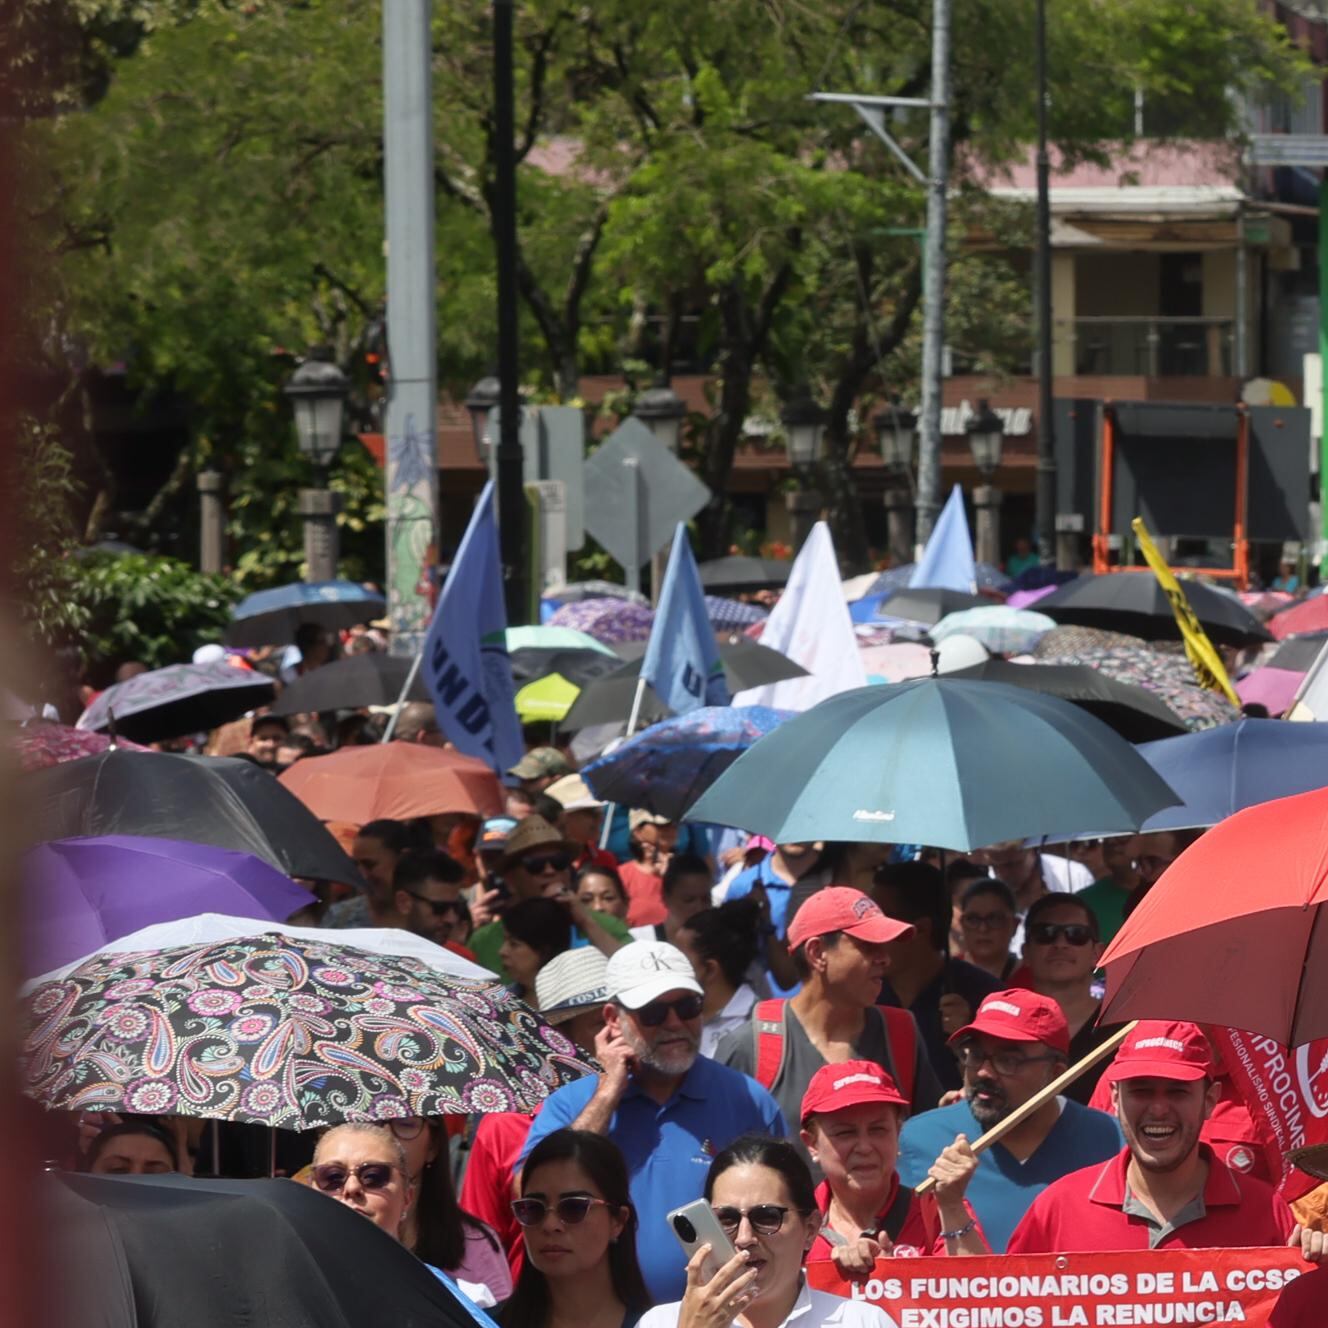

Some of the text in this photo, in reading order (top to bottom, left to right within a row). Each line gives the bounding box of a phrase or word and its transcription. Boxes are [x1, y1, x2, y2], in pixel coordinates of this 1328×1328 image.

[852, 1279, 902, 1301] LOS
[911, 1273, 1128, 1300] FUNCIONARIOS
[1137, 1272, 1175, 1294] DE
[1183, 1271, 1219, 1293] LA
[901, 1301, 1245, 1328] EXIGIMOS LA RENUNCIA
